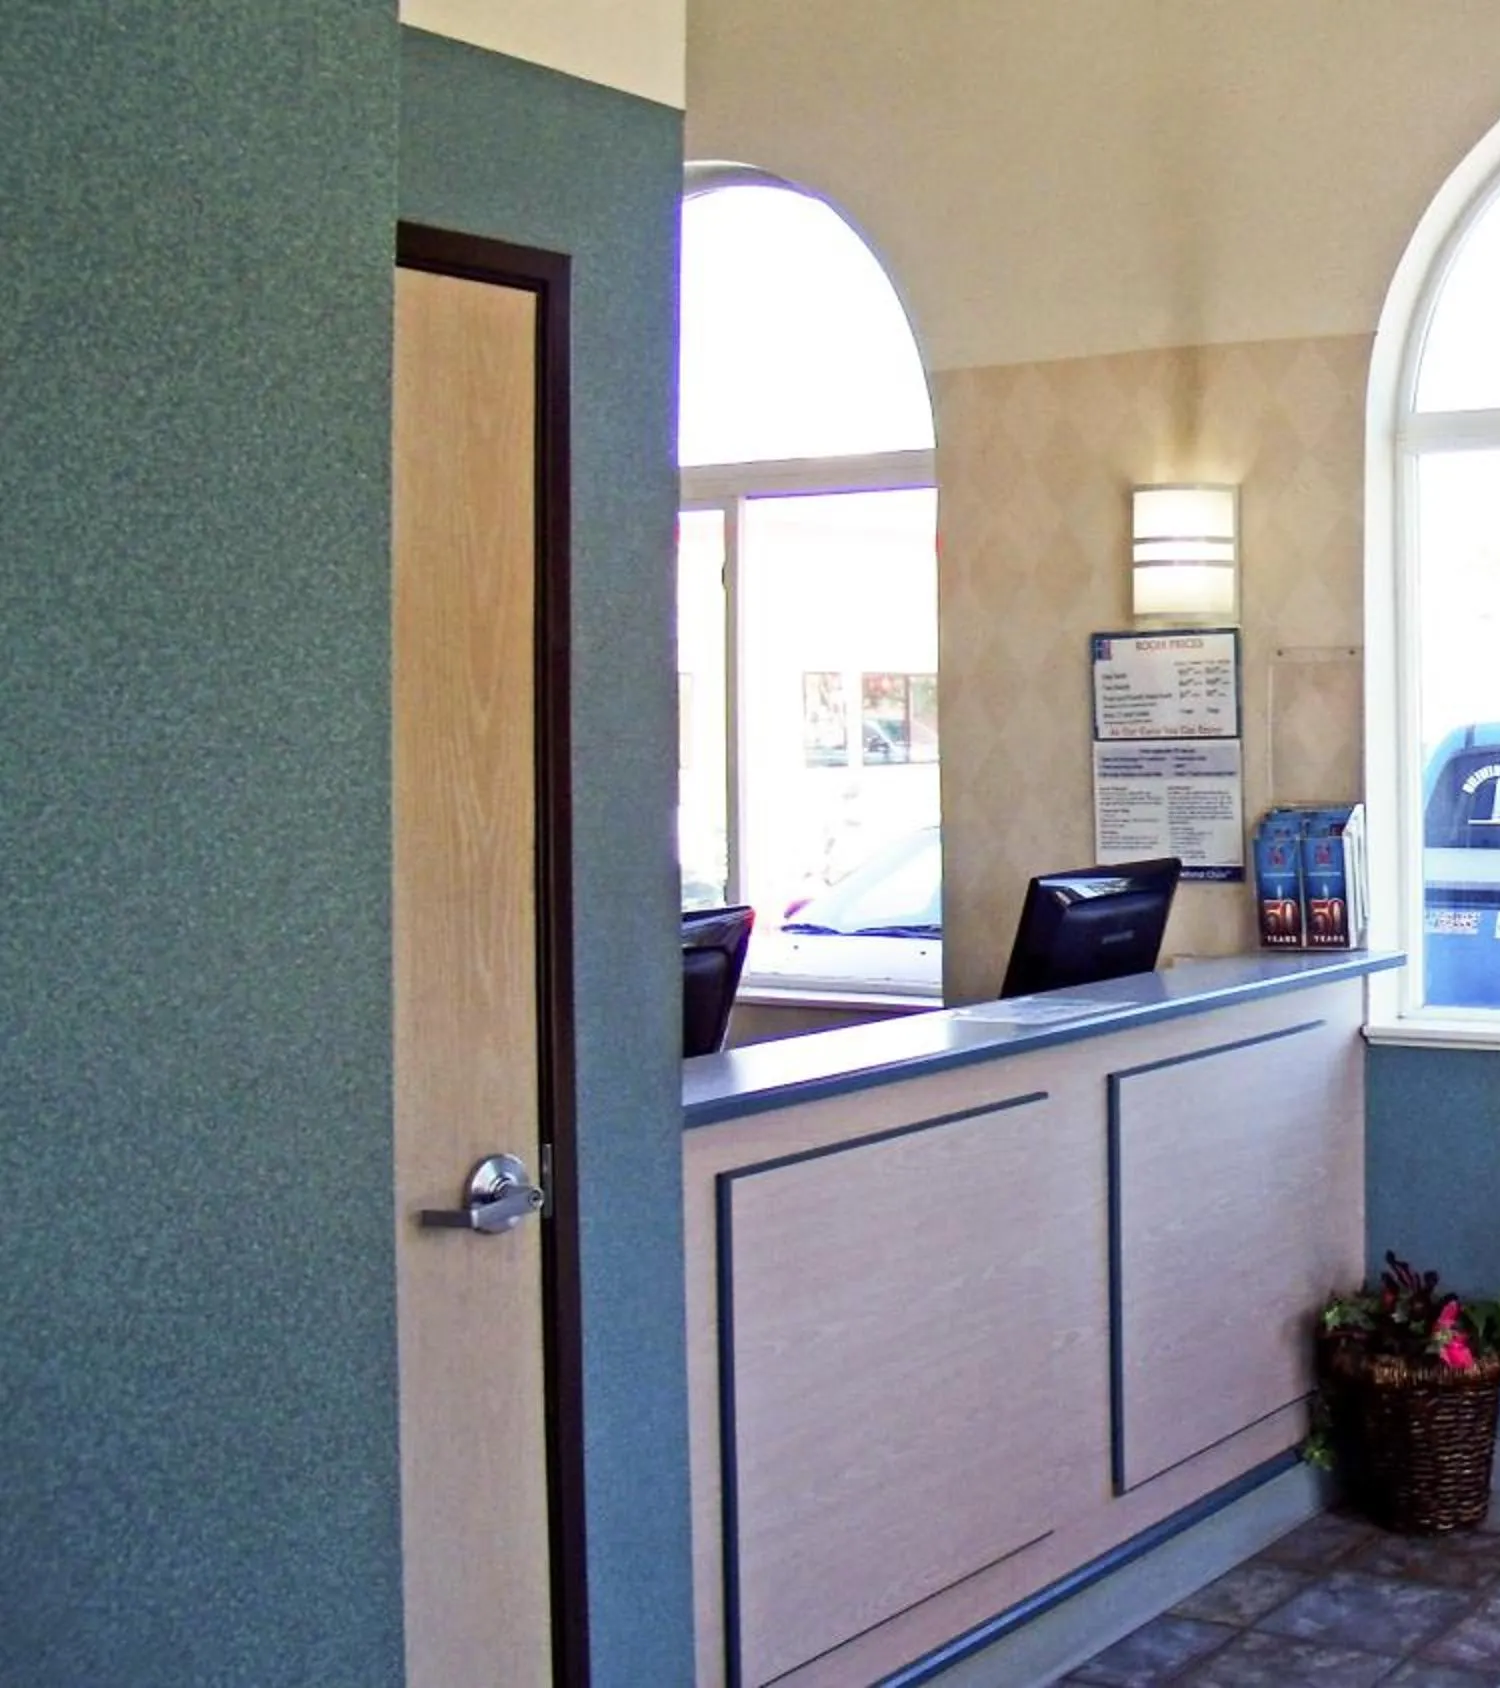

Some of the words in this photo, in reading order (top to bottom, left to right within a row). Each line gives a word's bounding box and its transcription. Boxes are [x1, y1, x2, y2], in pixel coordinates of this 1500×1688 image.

[1135, 639, 1167, 651] ROOM
[1264, 899, 1299, 934] 50
[1311, 898, 1345, 934] 50
[1267, 935, 1297, 943] YEARS
[1314, 935, 1344, 943] YEARS
